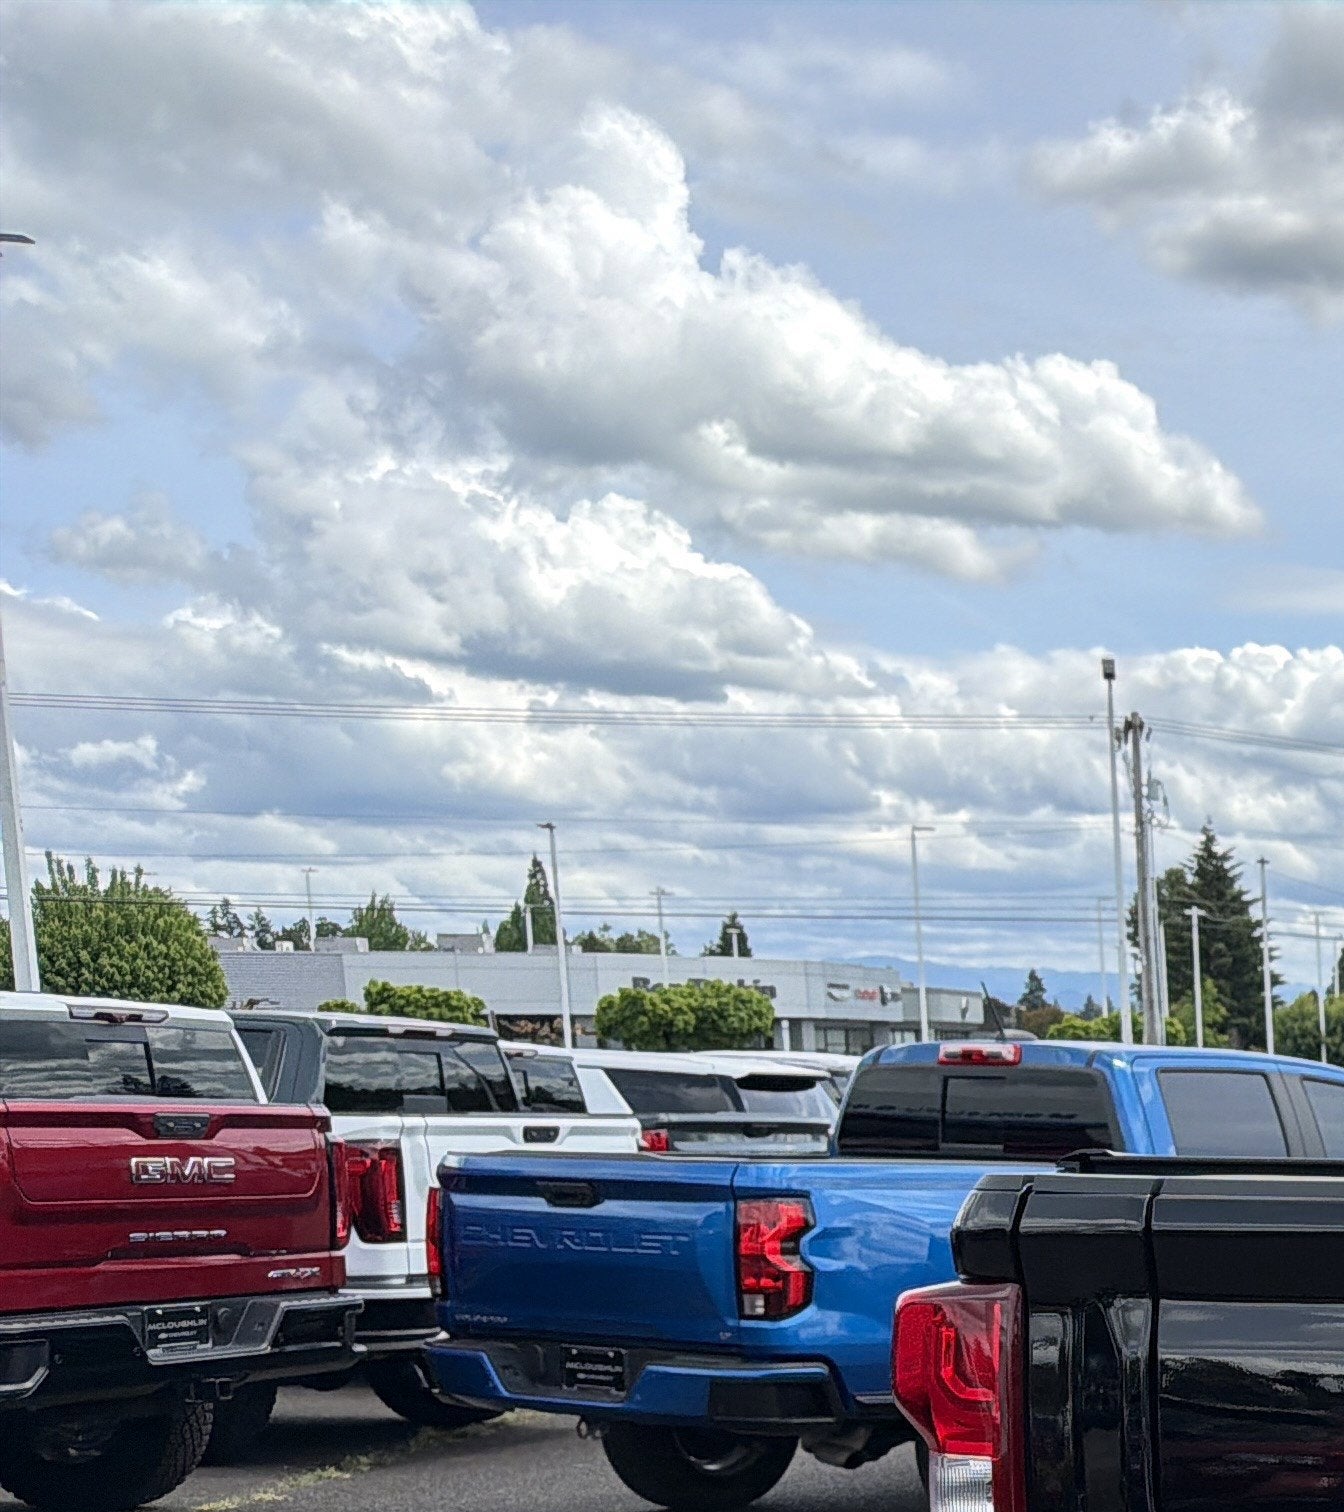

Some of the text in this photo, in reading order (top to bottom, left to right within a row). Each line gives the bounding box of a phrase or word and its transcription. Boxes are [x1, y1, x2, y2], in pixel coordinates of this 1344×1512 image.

[130, 1156, 237, 1185] GMC
[460, 1225, 692, 1256] CHEVROLET
[146, 1318, 208, 1331] MCLOUGHLIN
